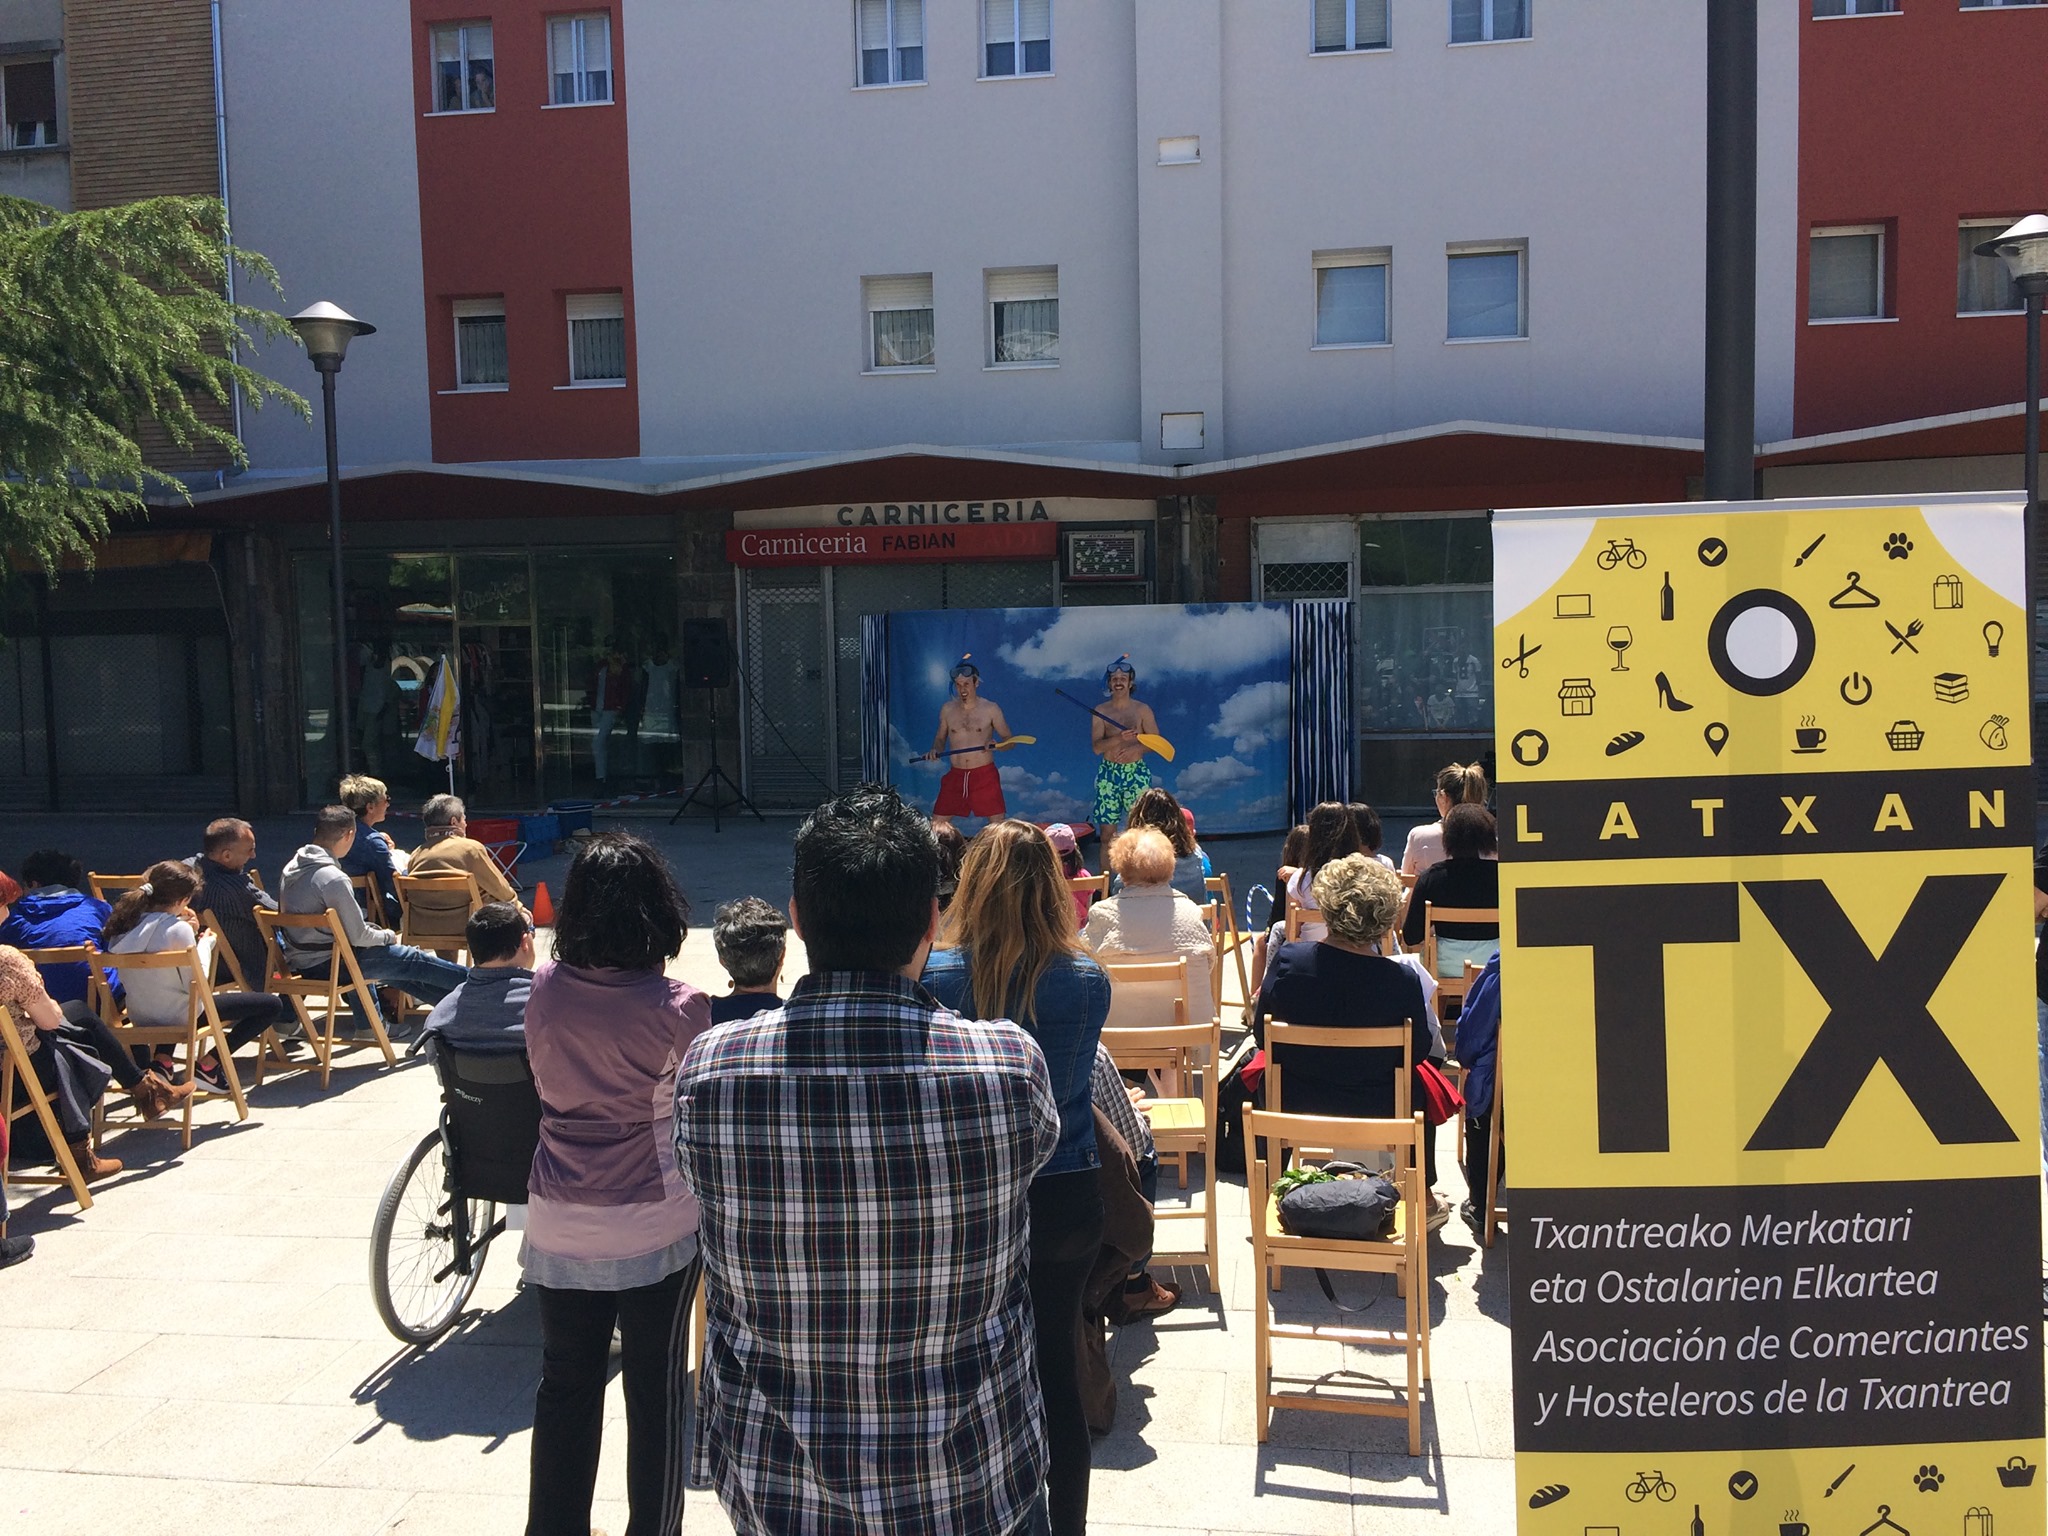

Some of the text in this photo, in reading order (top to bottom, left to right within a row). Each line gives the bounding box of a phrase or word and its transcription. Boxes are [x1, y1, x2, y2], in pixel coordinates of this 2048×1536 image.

[837, 500, 1049, 526] CARNICERIA
[741, 532, 955, 557] Carniceria FABIAN
[1515, 789, 2006, 843] LATXAN
[1515, 873, 2020, 1153] TX
[1530, 1208, 1913, 1249] Txantreako Merkatari
[1529, 1263, 1938, 1304] eta Ostalarien Elkartea
[1532, 1320, 2030, 1363] Asociación de Comerciantes
[1533, 1376, 2012, 1426] y Hosteleros de la Txantrea
